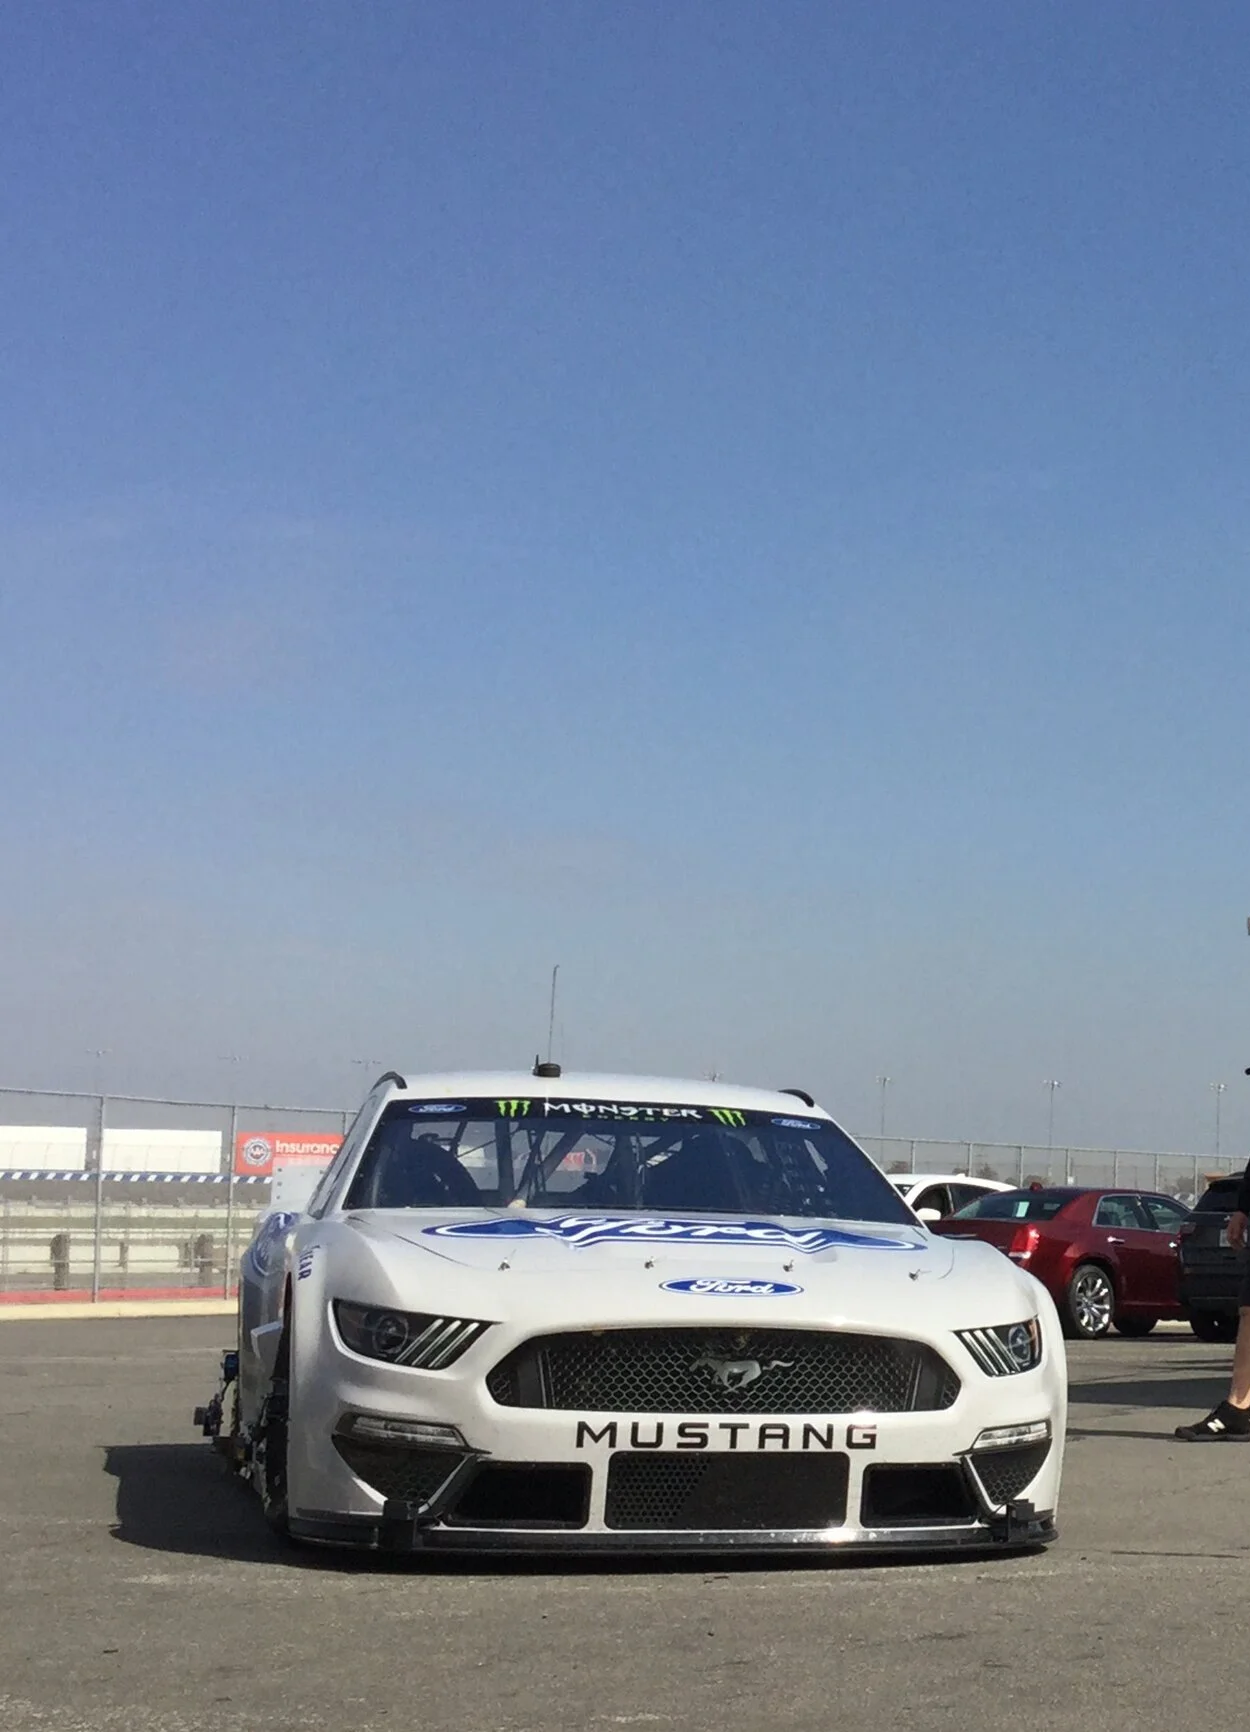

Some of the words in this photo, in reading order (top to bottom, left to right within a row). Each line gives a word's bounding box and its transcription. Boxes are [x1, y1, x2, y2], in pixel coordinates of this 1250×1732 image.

[543, 1102, 703, 1119] MONSTER
[275, 1140, 340, 1154] Insuranc
[535, 1217, 826, 1249] Ford
[689, 1280, 775, 1295] Ford
[575, 1421, 877, 1450] MUSTANG
